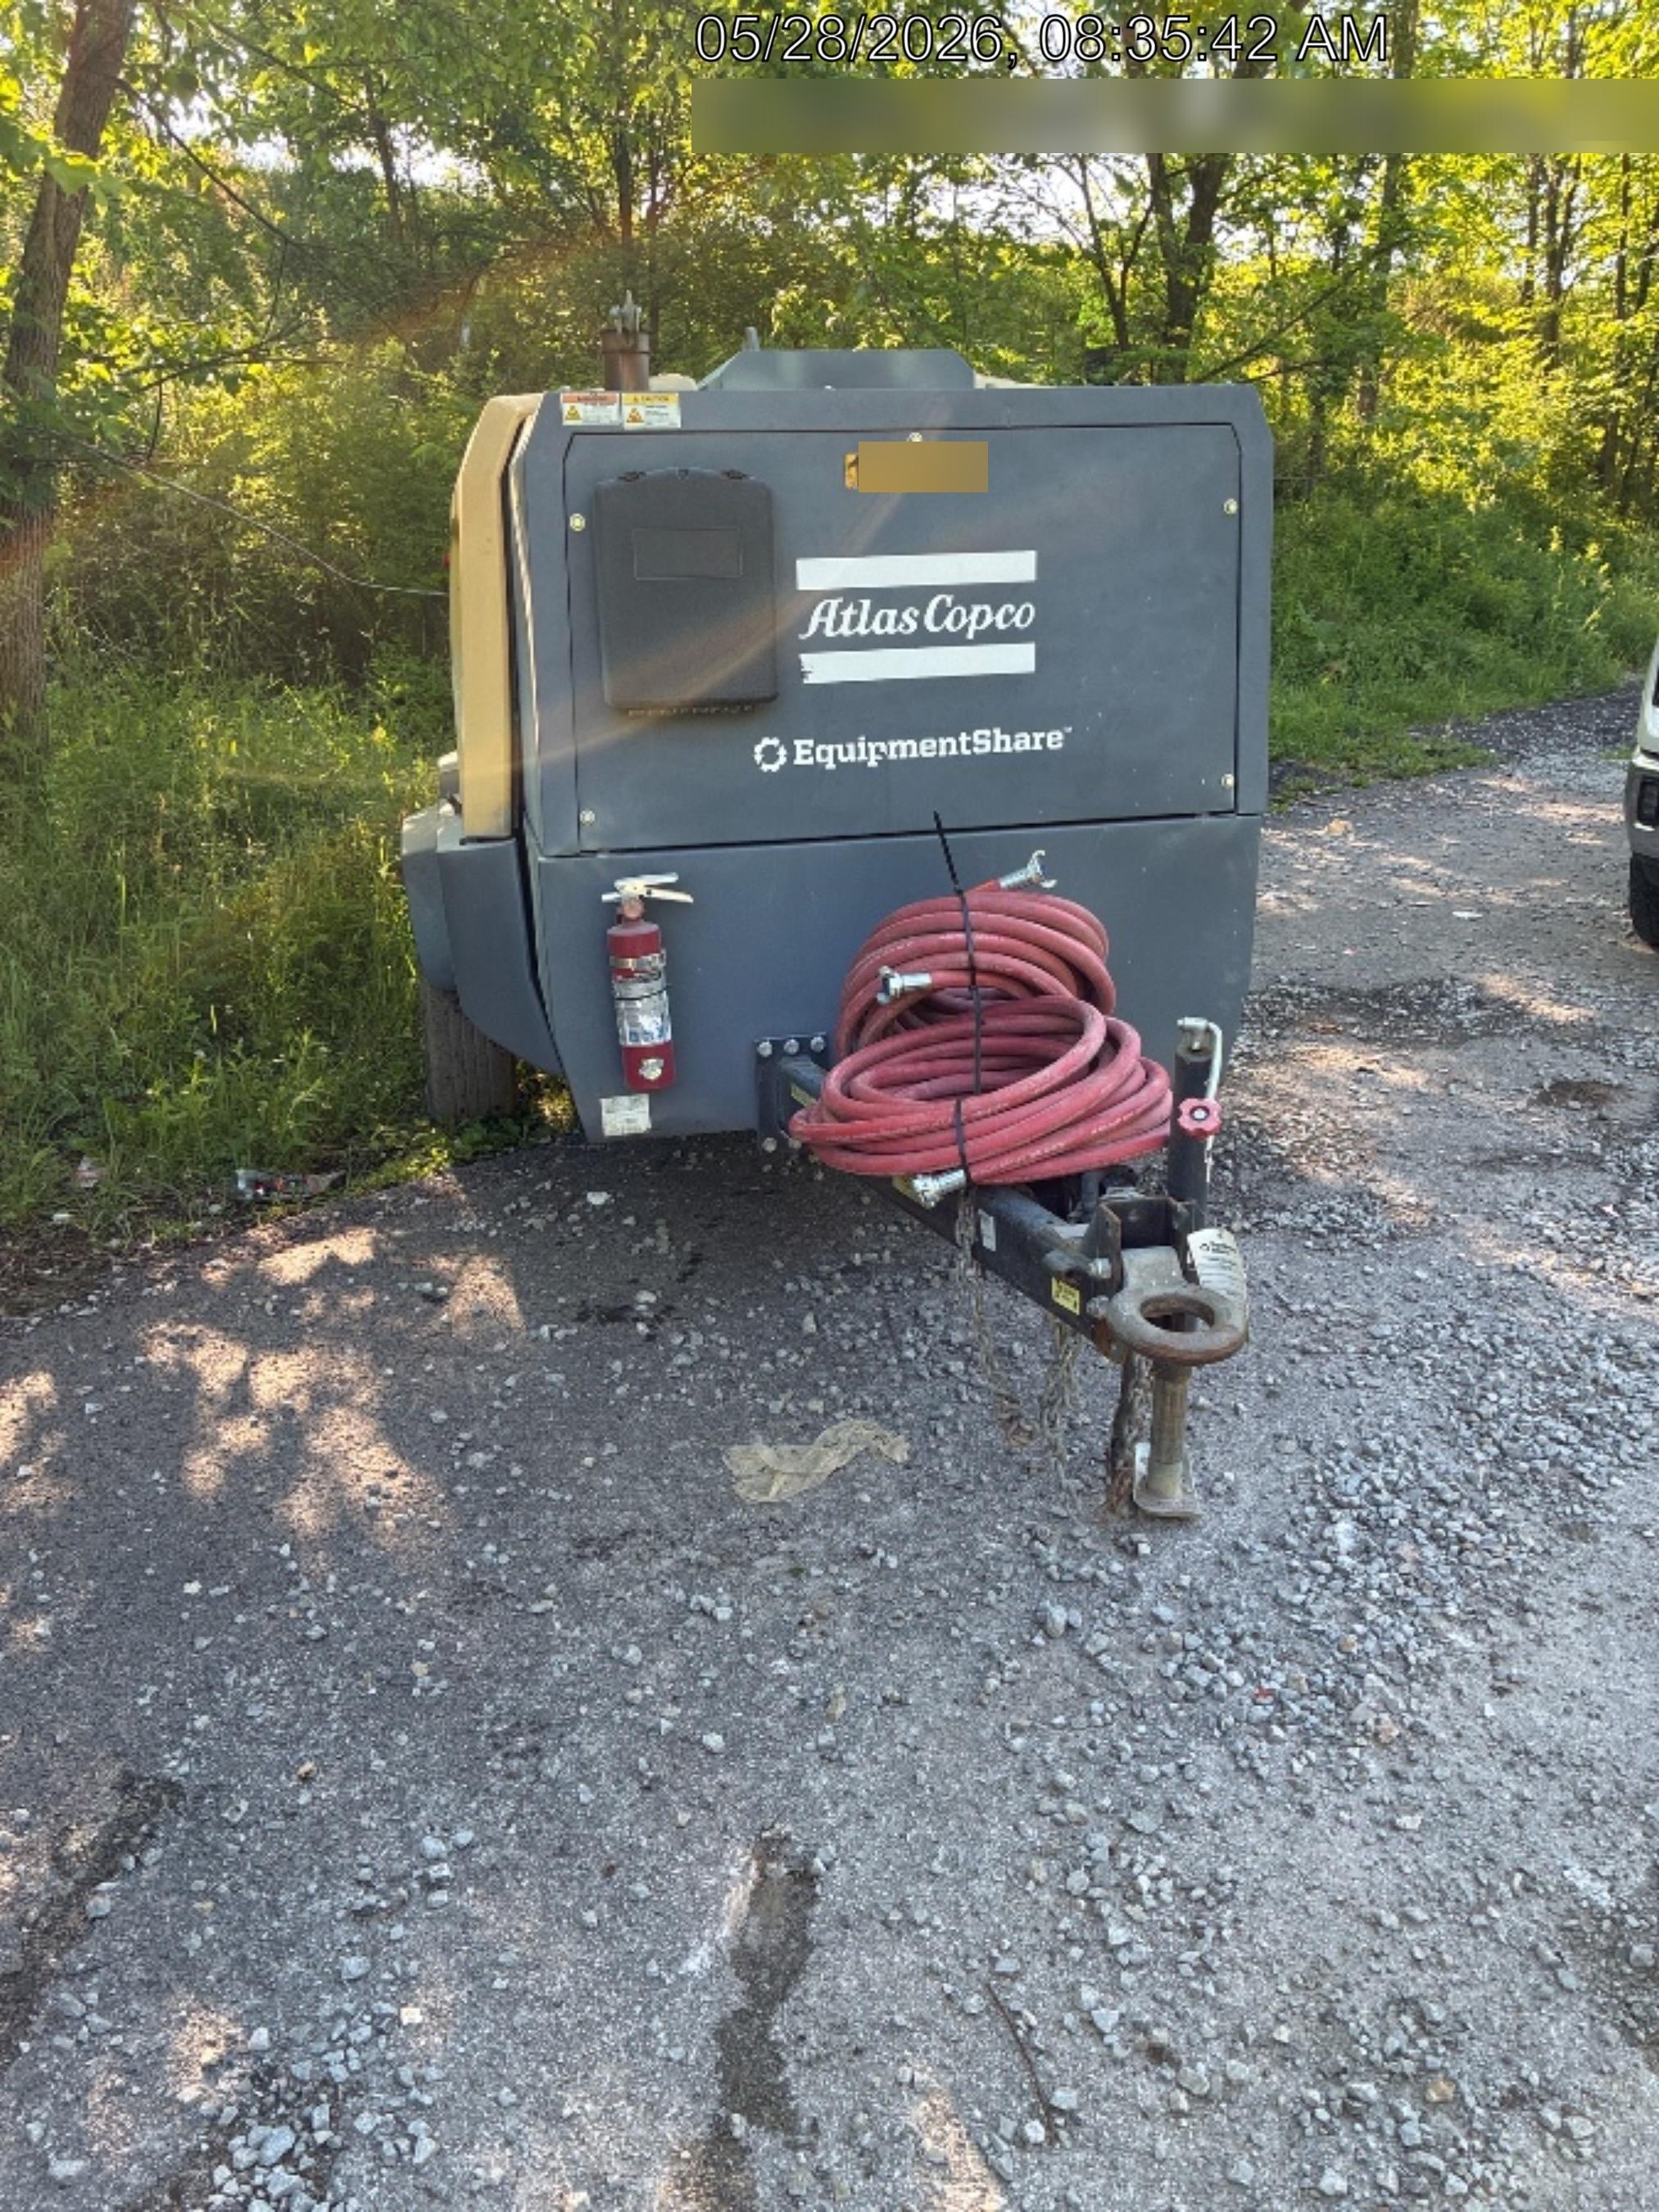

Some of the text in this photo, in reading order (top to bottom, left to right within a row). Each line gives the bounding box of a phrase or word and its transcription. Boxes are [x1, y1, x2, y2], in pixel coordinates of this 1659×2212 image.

[798, 594, 1036, 640] Atlas Copco
[793, 727, 1065, 770] EquipmentShare
